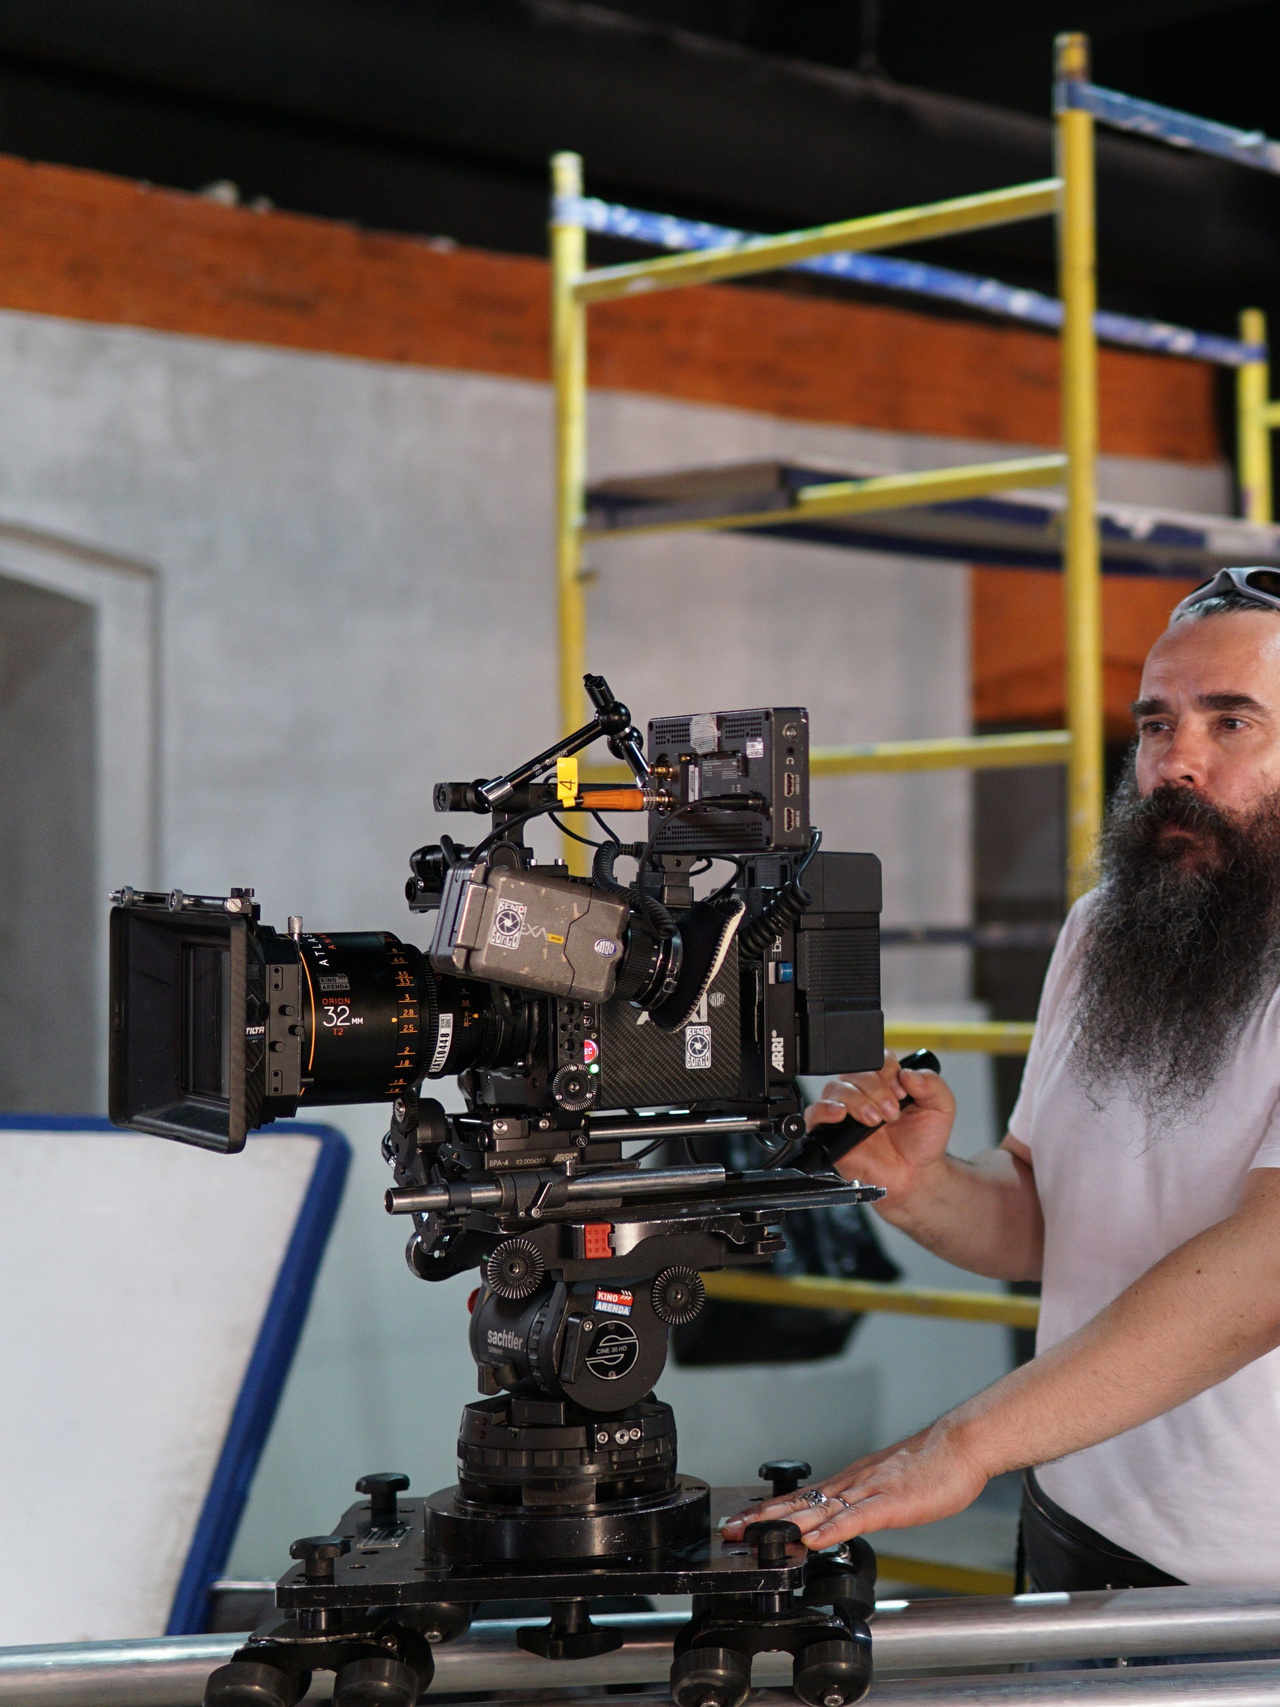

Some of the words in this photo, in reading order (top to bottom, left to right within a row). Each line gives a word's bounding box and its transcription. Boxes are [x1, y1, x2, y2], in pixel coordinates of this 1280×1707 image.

[559, 780, 576, 791] 4
[302, 934, 330, 967] ATLAS
[245, 1026, 265, 1035] TILTA
[332, 1028, 344, 1036] T2
[772, 1037, 784, 1073] ARRI
[489, 1159, 509, 1167] BPA-4
[597, 1291, 618, 1303] KINO
[594, 1302, 630, 1316] ARENDA
[487, 1329, 523, 1351] sachtler
[595, 1347, 610, 1355] CINE
